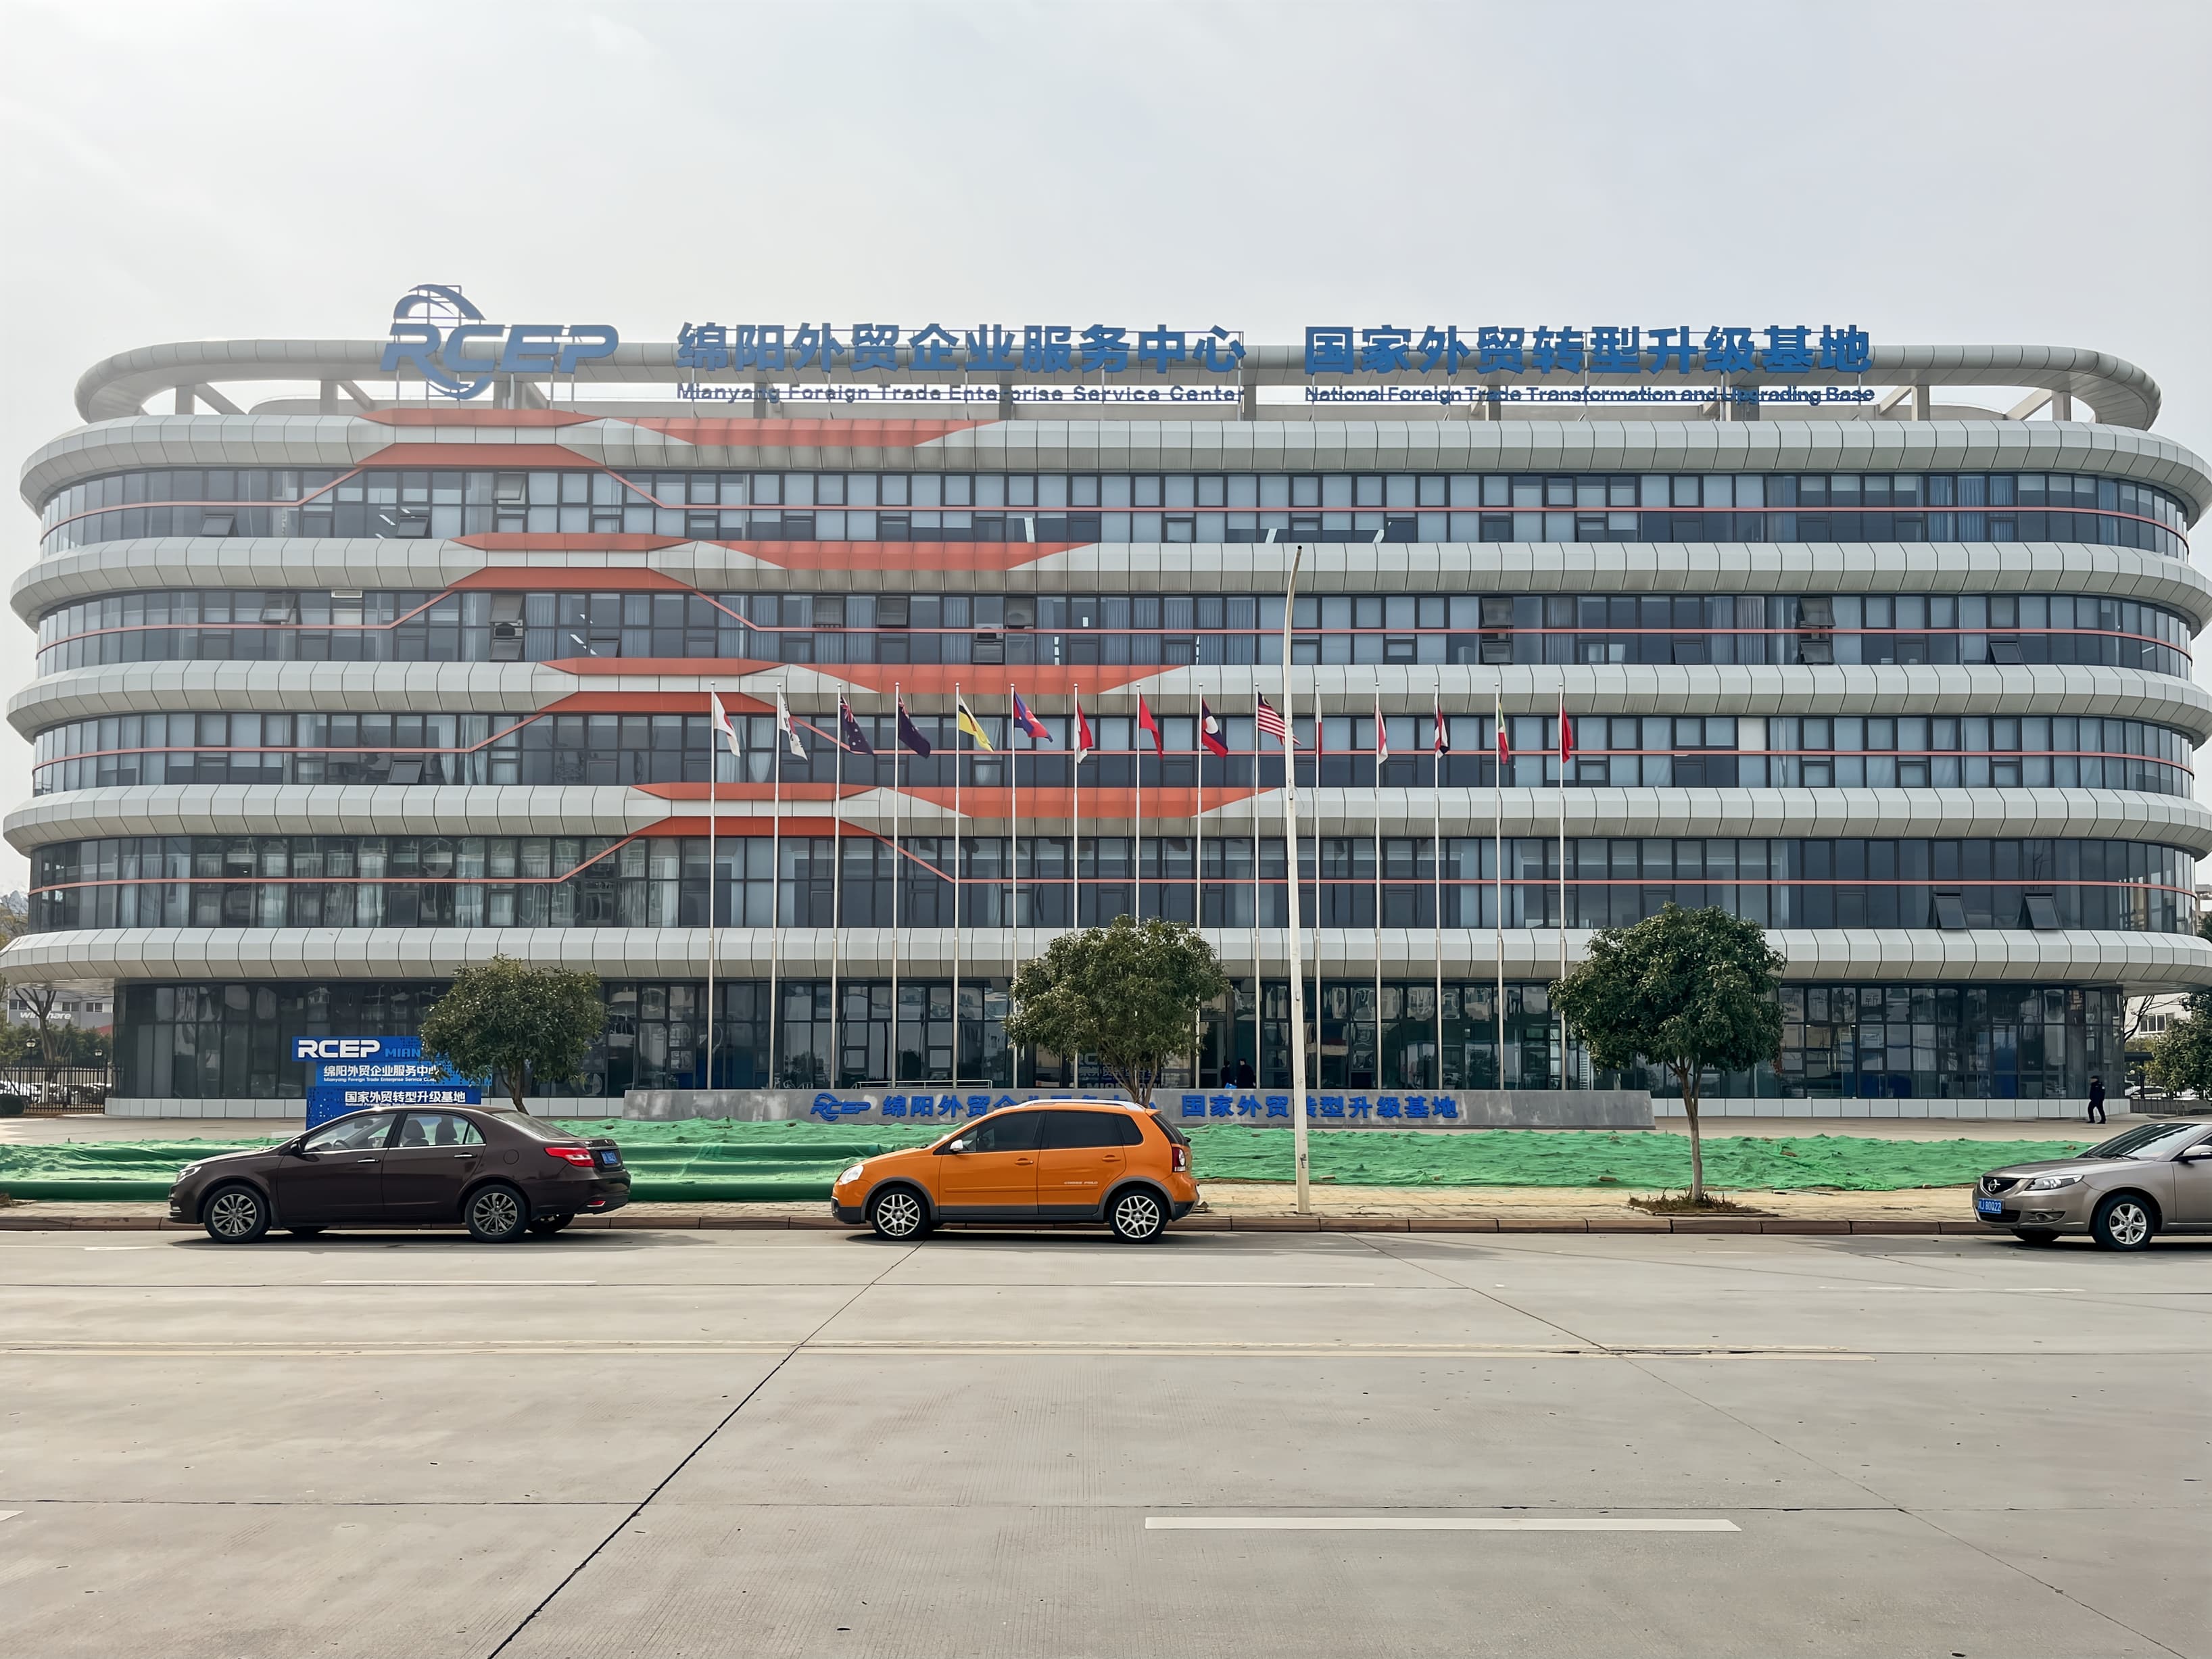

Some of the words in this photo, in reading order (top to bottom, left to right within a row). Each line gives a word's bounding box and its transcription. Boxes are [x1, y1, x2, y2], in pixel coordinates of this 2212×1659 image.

[677, 321, 1246, 373] 绵阳外贸企业服务中心
[1304, 324, 1871, 375] 国家外贸转型升级基地
[379, 323, 619, 400] RCEP
[677, 383, 780, 404] Mianyang
[789, 383, 869, 403] Foreign
[877, 384, 940, 400] Trade
[950, 385, 1063, 405] Enterprise
[1074, 384, 1160, 401] Service
[1170, 384, 1245, 402] Center
[1305, 385, 1384, 402] National
[1389, 385, 1461, 405] Foreign
[1464, 385, 1522, 402] Trade
[1526, 385, 1677, 402] Transformation
[1681, 386, 1717, 402] and
[1723, 385, 1821, 406] Upgrading
[1826, 387, 1875, 402] Base
[20, 1011, 72, 1019] winhare
[297, 1039, 380, 1058] RCEP
[345, 1090, 466, 1103] 国家外贸转型升级基地
[811, 1101, 871, 1122] RCEP
